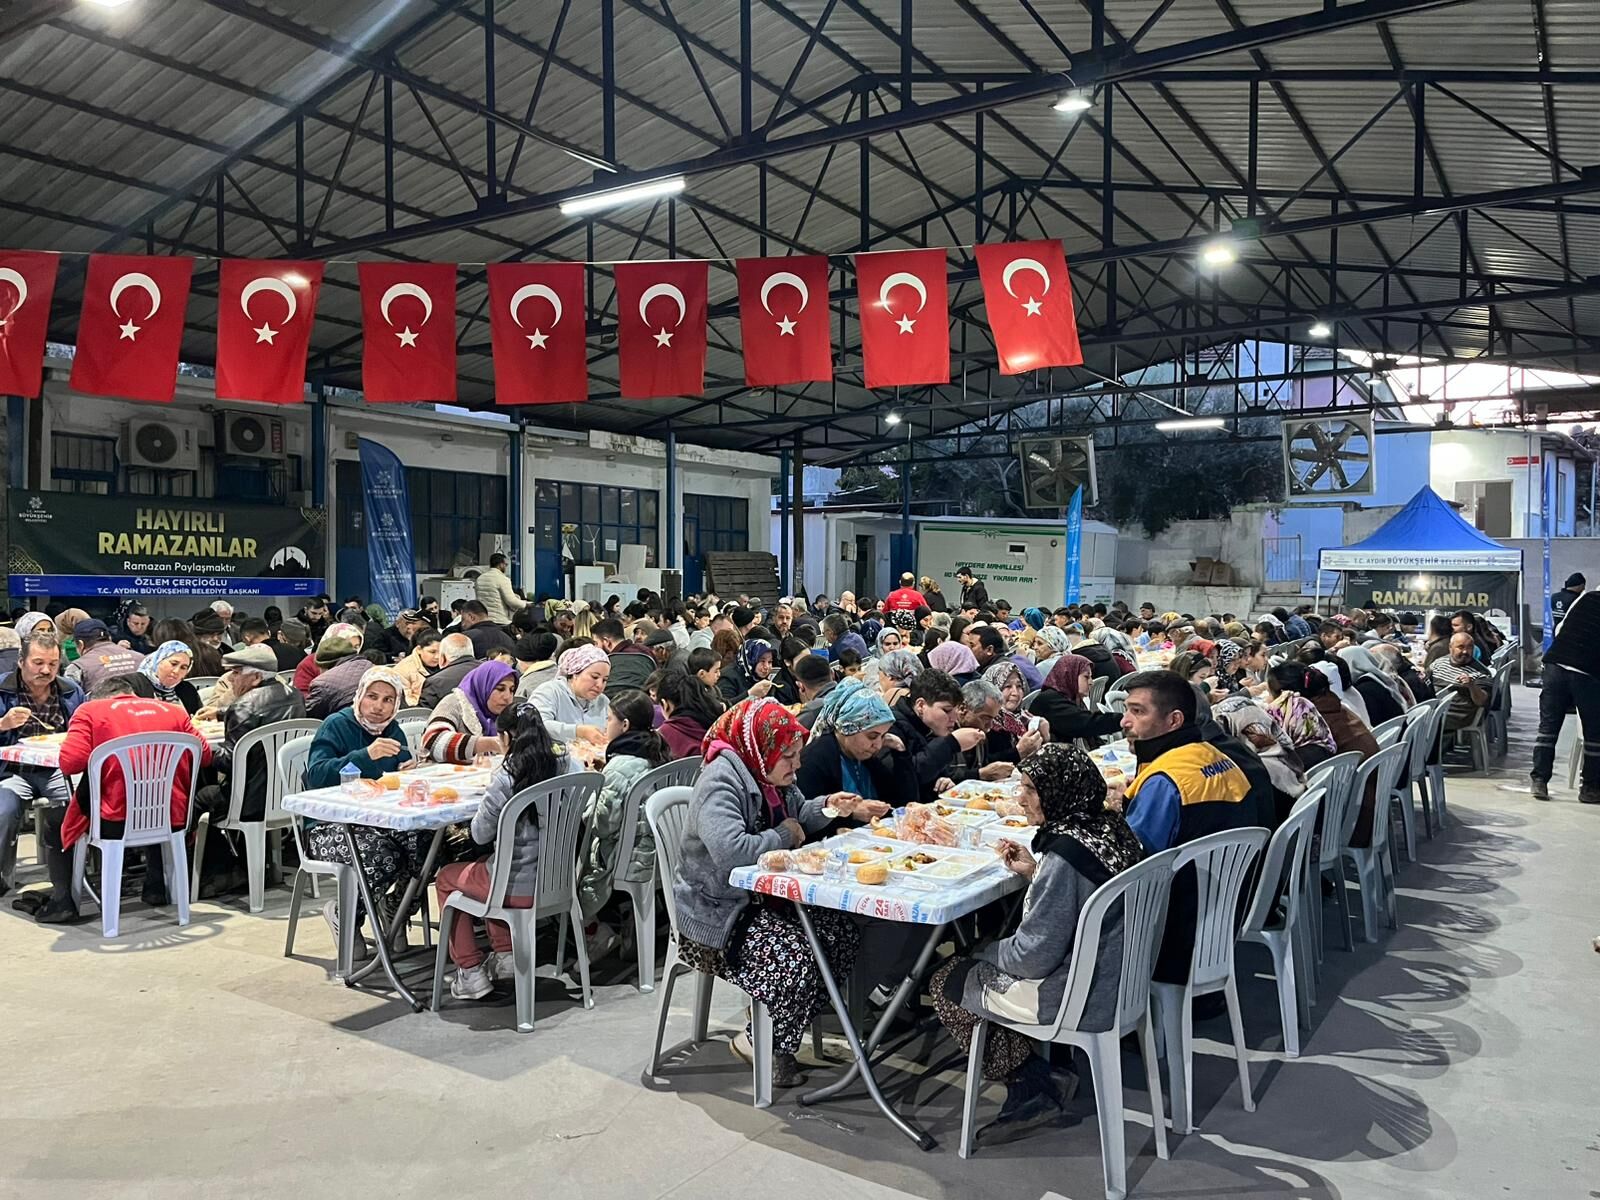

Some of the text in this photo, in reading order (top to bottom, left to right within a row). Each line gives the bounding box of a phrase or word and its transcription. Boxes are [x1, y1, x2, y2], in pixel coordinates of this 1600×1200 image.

[136, 508, 224, 533] HAYIRLI
[98, 531, 257, 558] RAMAZANLAR
[123, 561, 236, 574] Ramazan Paylaşmaktır
[1387, 555, 1439, 566] BÜYÜKŞEHİR
[134, 576, 228, 588] ÖZLEM ÇERÇİOĞLU
[97, 587, 112, 595] T.C.
[140, 586, 190, 596] BÜYÜKŞEHİR
[191, 587, 227, 595] BELEDİYE
[228, 588, 260, 596] BAŞKANI
[1371, 591, 1489, 607] RAMAZANLAR
[789, 880, 800, 899] AYDI
[875, 899, 884, 916] 24
